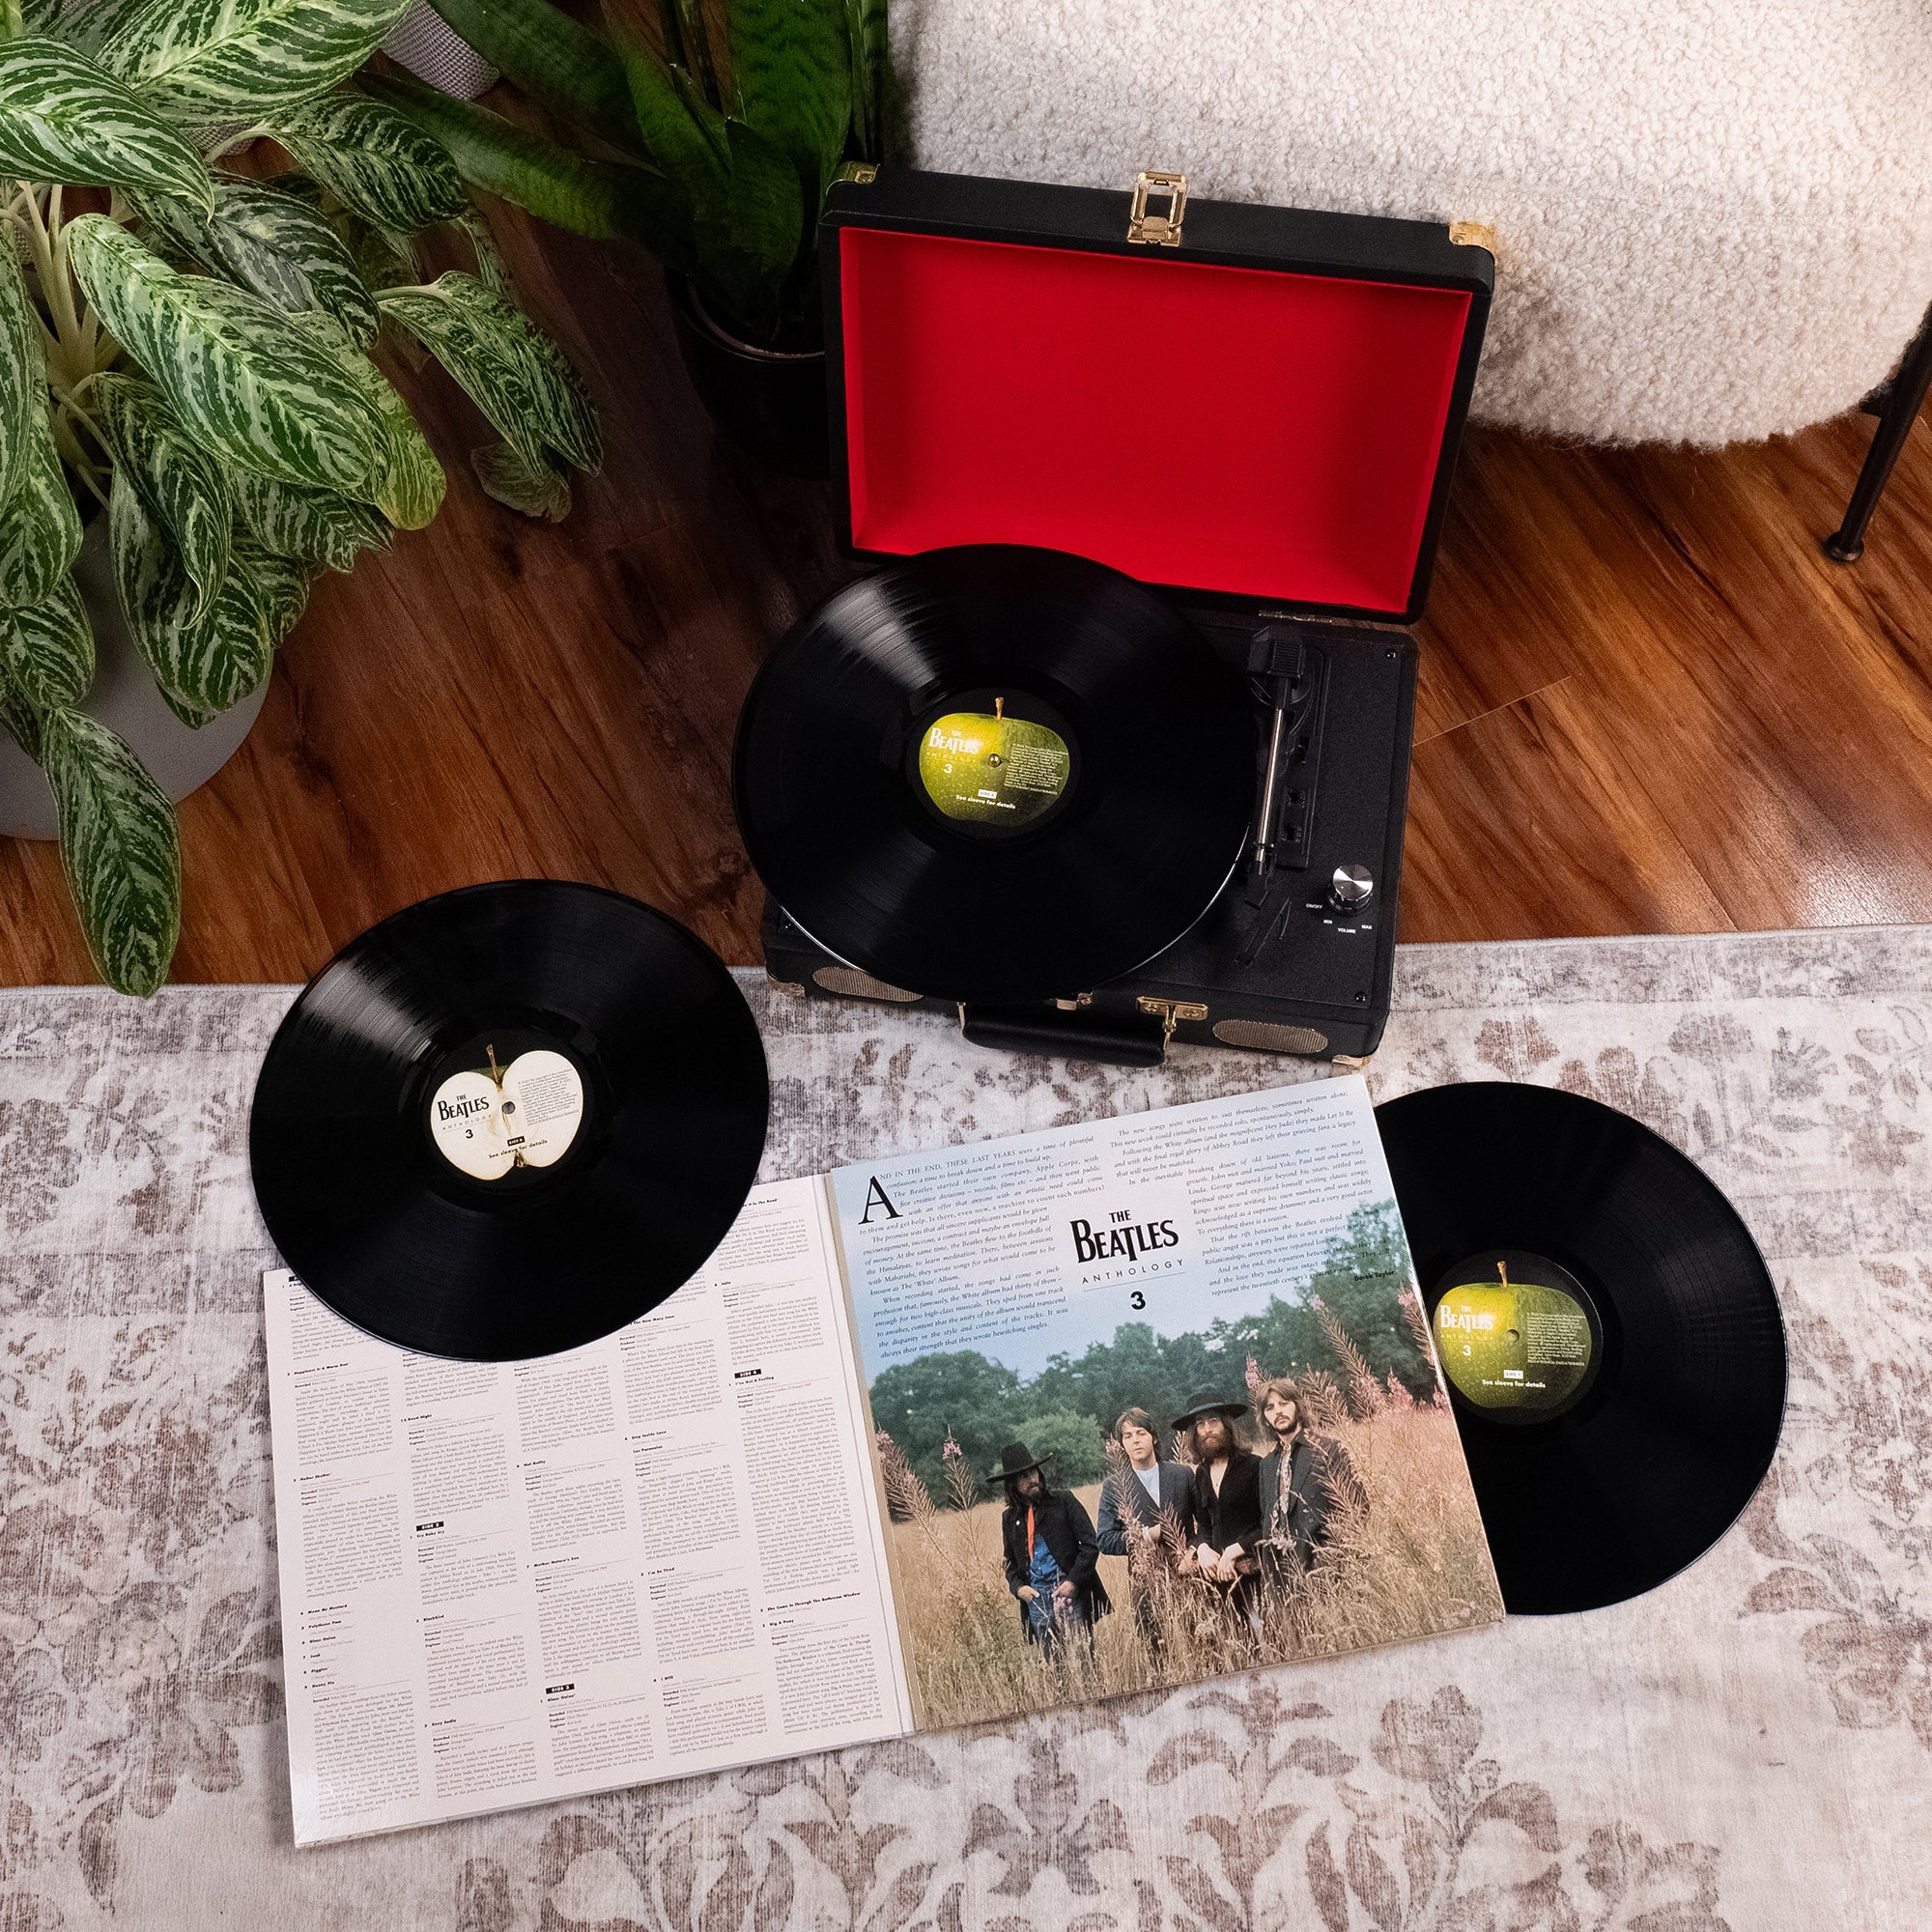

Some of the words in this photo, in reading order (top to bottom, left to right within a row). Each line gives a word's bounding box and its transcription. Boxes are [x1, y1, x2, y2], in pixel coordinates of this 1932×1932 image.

[928, 727, 980, 753] BEATLES
[944, 763, 952, 774] 3
[438, 1096, 490, 1121] BEATLES
[465, 1128, 473, 1139] 3
[500, 1148, 518, 1156] sleeve
[528, 1139, 548, 1148] details
[1108, 1209, 1131, 1223] THE
[1069, 1219, 1179, 1264] BEATLES
[1082, 1259, 1183, 1285] ANTHOLOGY
[1130, 1291, 1146, 1310] 3
[1440, 1305, 1494, 1333] BEATLES
[1463, 1345, 1471, 1356] 3
